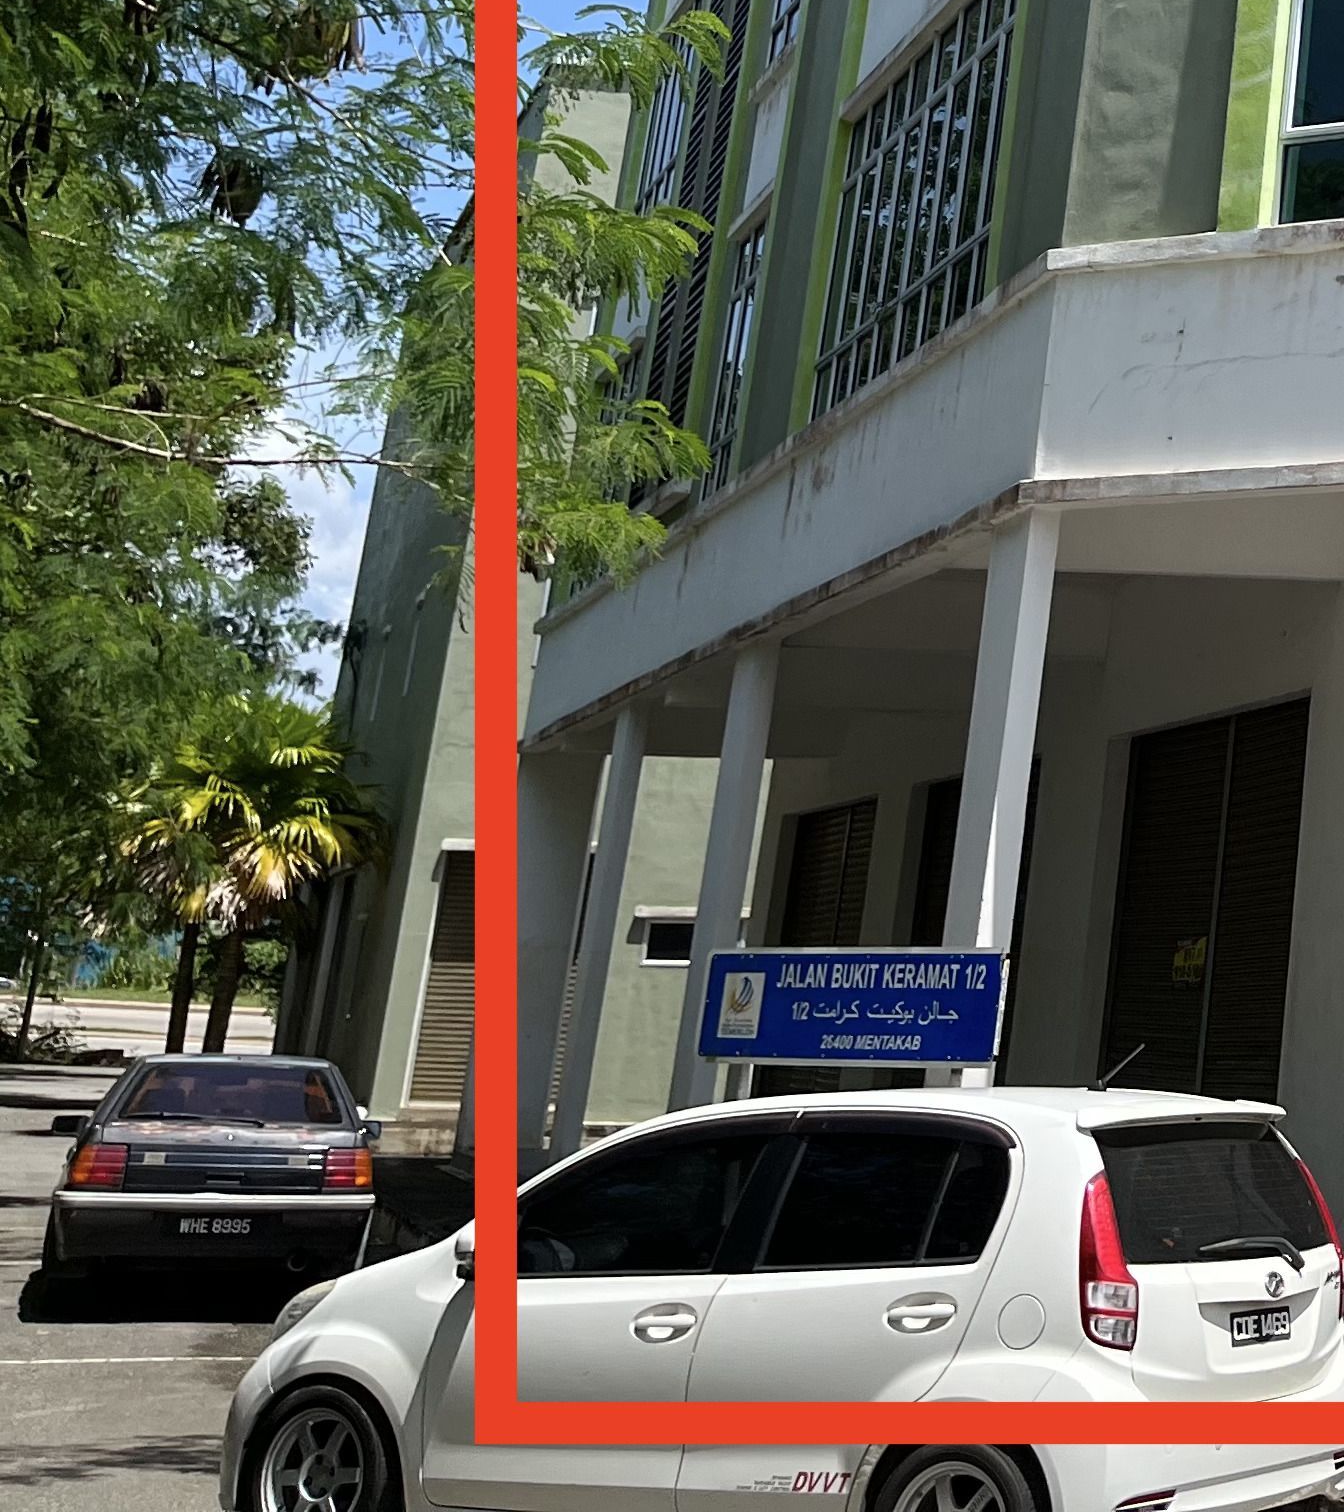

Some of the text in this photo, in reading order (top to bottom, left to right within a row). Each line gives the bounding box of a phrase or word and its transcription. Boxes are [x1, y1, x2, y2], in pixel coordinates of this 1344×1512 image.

[776, 963, 987, 990] JALAN BUKIT KERAMAT 1/2
[854, 1034, 921, 1050] MENTAKAB
[180, 1217, 252, 1234] WHE 8995
[791, 1471, 851, 1493] DVVT
